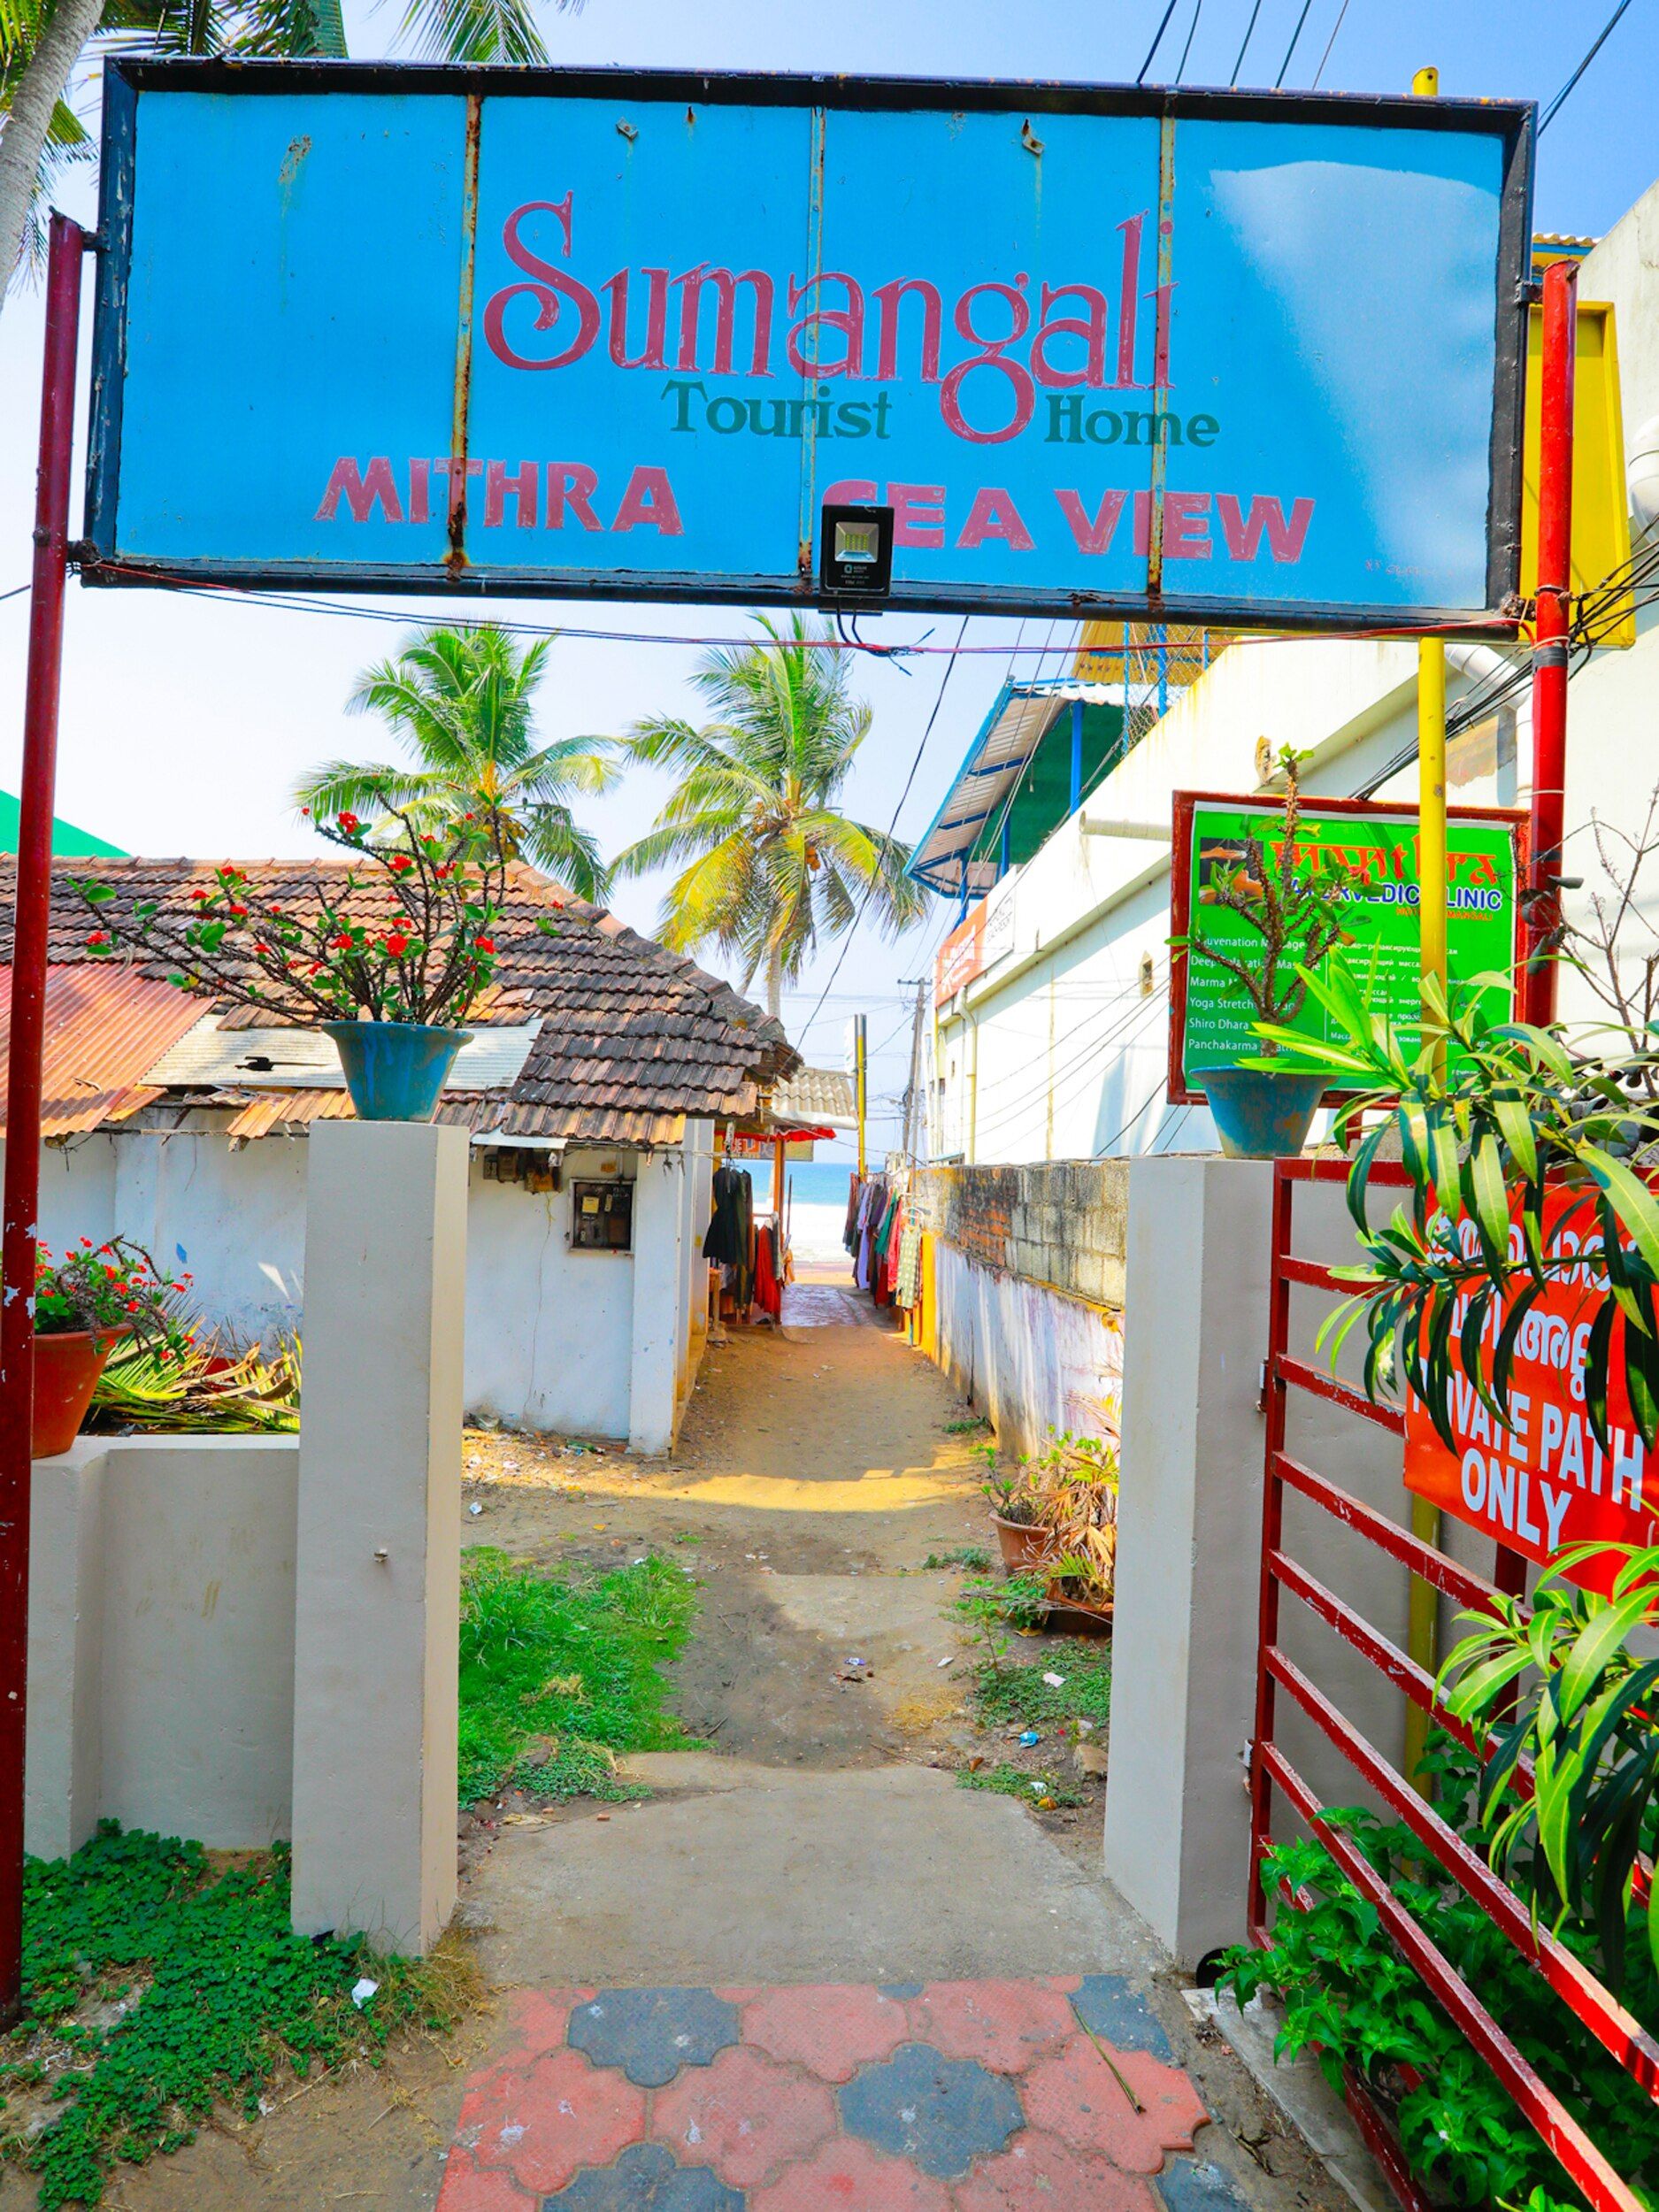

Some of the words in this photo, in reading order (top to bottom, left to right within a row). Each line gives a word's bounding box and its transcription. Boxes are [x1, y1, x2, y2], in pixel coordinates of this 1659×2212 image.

[484, 189, 1179, 444] Sumangali
[661, 380, 893, 440] Tourist
[1045, 394, 1220, 447] Home
[312, 457, 685, 535] MITHRA
[1054, 488, 1316, 564] VIEW
[1446, 886, 1502, 910] LINIC
[1447, 910, 1494, 922] MANGALI
[1194, 937, 1258, 948] uvenation
[1190, 977, 1226, 988] Marma
[1190, 997, 1214, 1010] Yoga
[1188, 1018, 1216, 1030] Shiro
[1218, 1019, 1249, 1030] Dhara
[1188, 1038, 1258, 1051] Panchakarma
[1413, 1356, 1532, 1463] IVATE
[1540, 1402, 1645, 1513] PATH
[1461, 1447, 1572, 1555] ONLY
